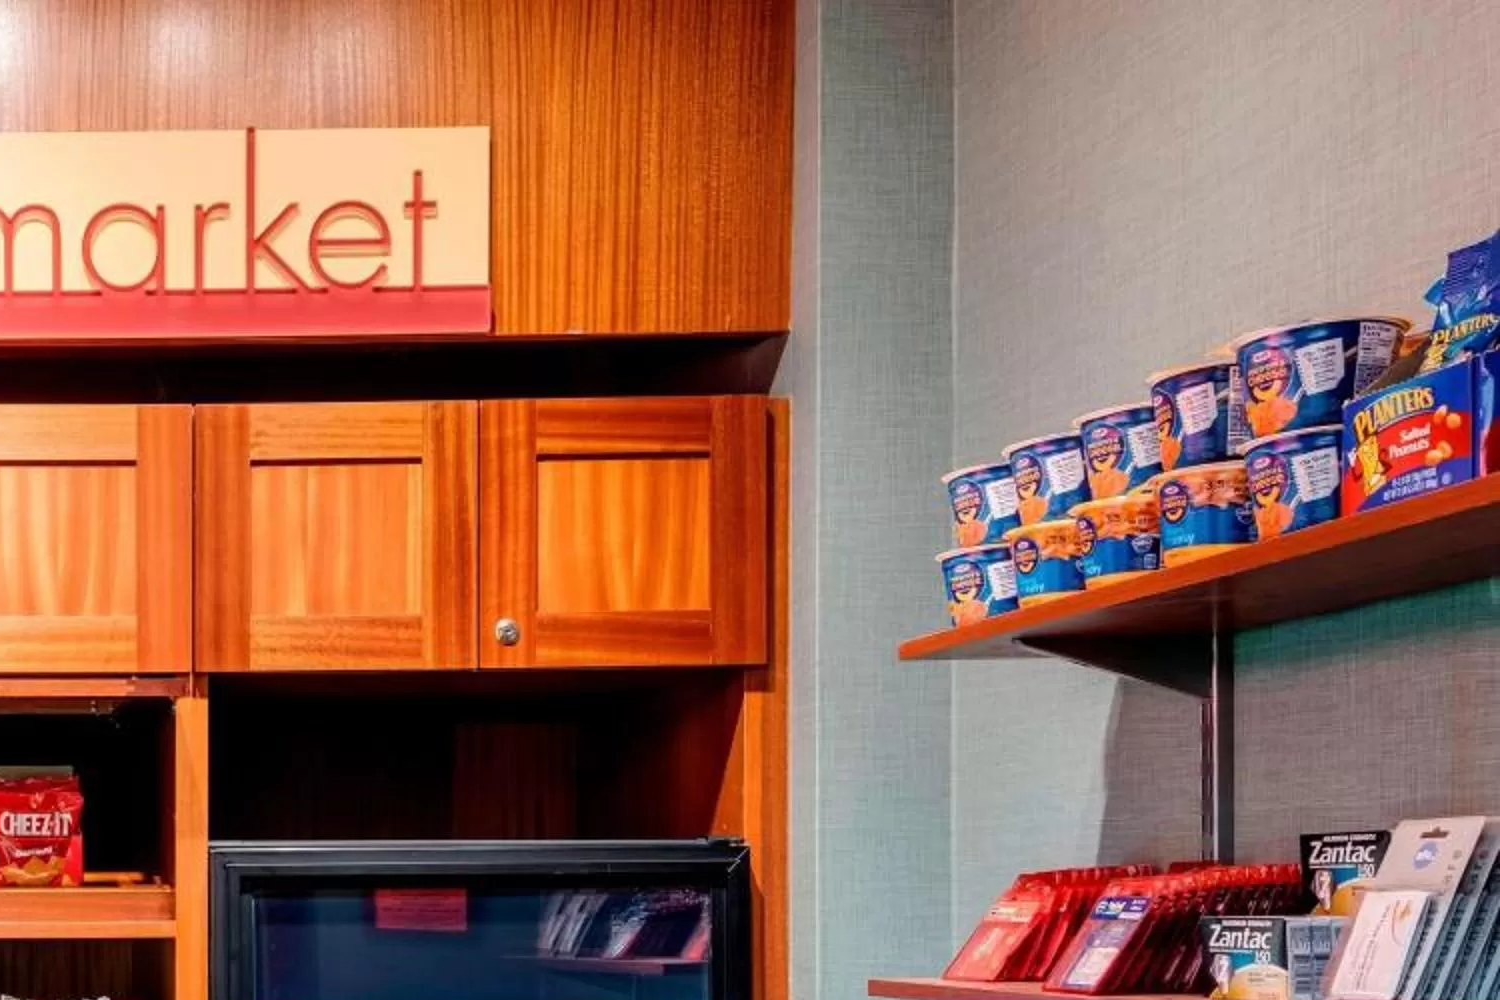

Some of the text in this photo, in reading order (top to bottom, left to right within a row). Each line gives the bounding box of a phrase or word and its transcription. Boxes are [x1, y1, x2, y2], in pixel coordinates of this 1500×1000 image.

[1354, 387, 1435, 443] PLANTERS
[1309, 840, 1377, 865] Zantac
[1208, 924, 1273, 950] Zantac
